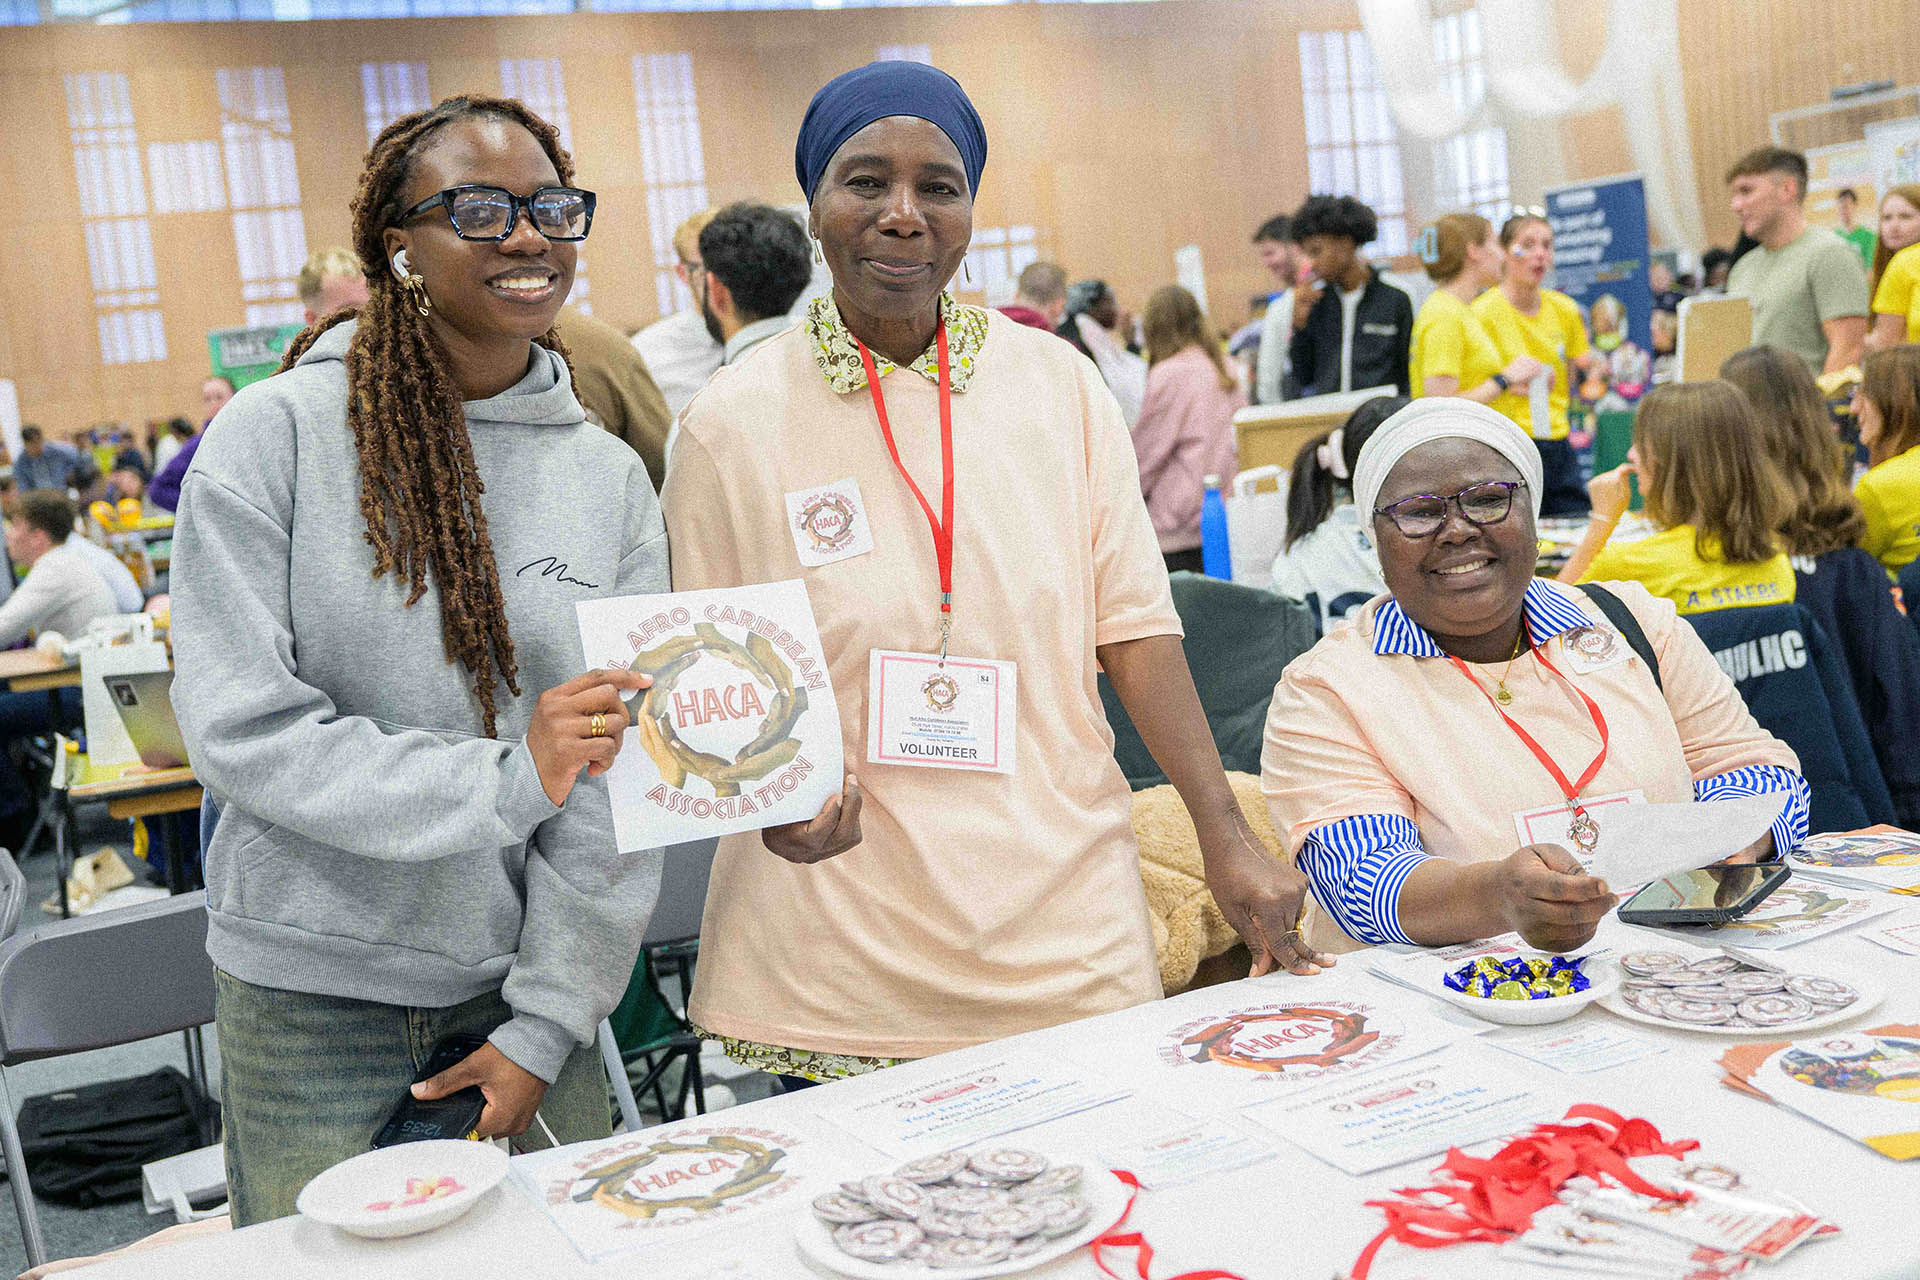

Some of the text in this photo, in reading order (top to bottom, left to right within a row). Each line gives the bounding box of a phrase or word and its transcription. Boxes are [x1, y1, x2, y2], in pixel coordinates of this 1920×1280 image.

[814, 513, 841, 530] HACA
[626, 604, 827, 691] AFRO CARIBBEAN
[673, 682, 766, 728] HACA
[900, 743, 977, 759] VOLUNTEER
[644, 754, 815, 820] ASSOCIATION
[1235, 1023, 1329, 1055] HACA
[401, 1118, 442, 1138] 12:35
[631, 1155, 737, 1195] HACA
